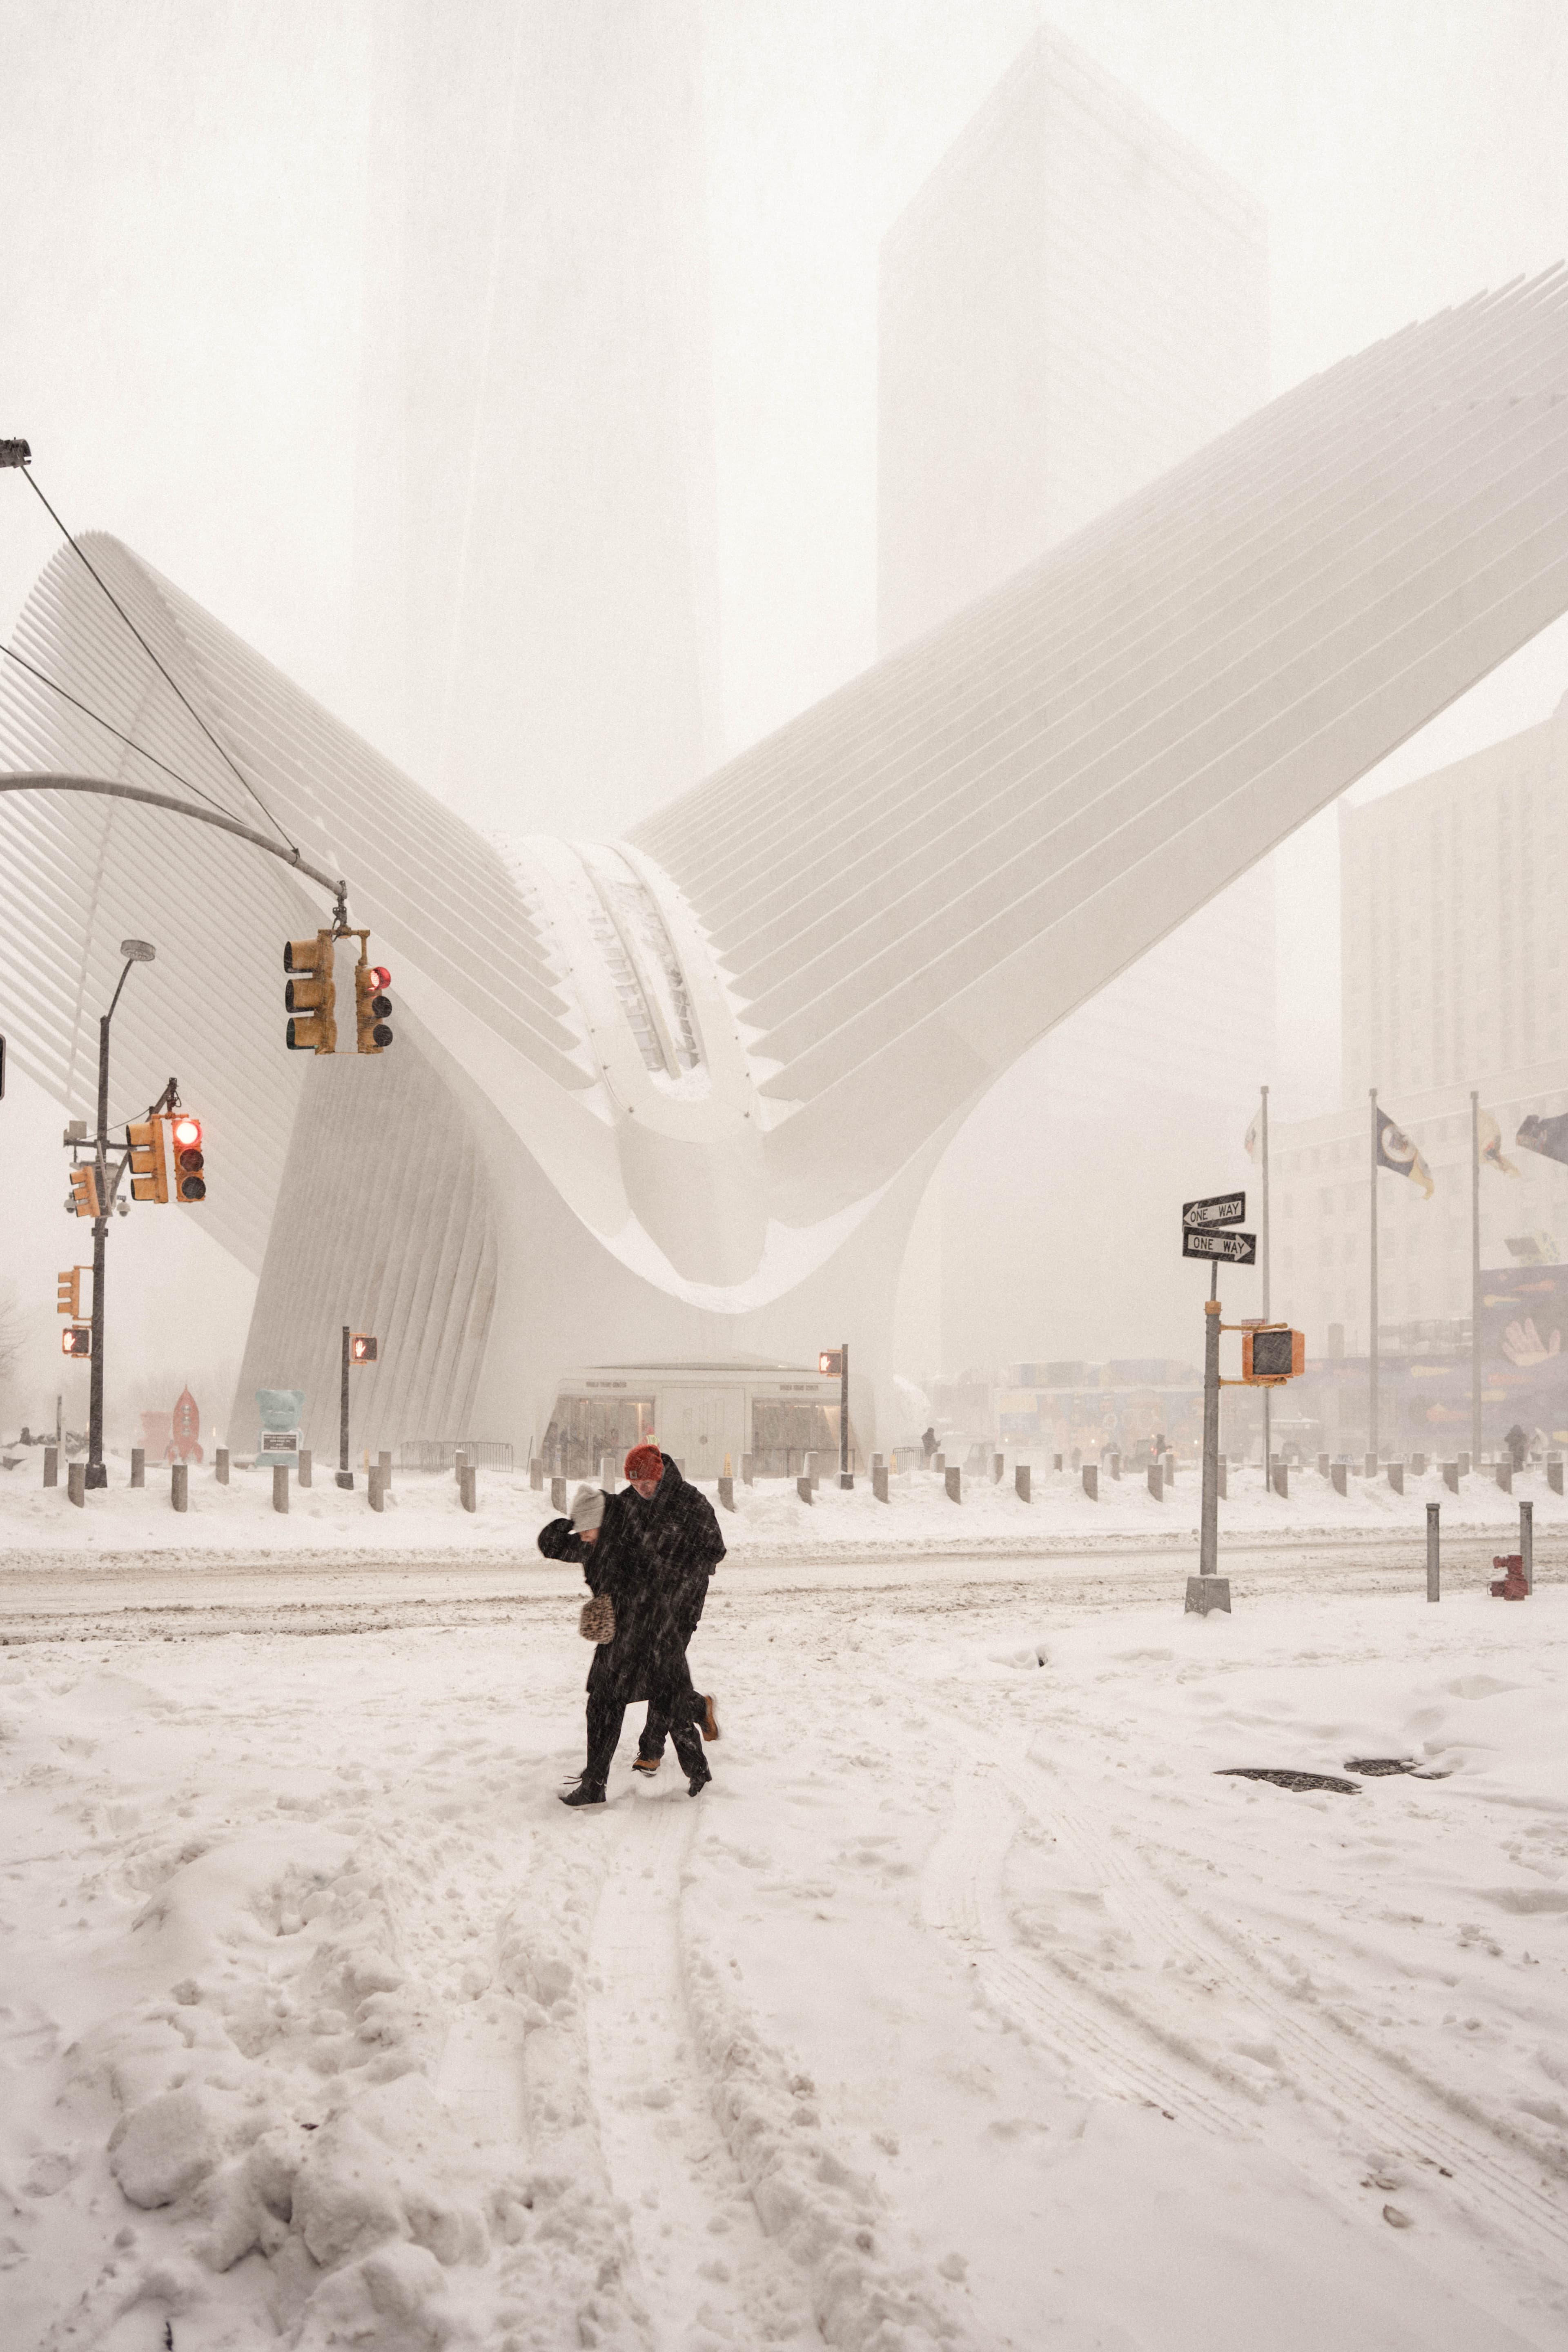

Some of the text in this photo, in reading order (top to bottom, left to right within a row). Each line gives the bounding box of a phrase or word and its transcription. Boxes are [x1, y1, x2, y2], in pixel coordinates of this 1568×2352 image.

[1190, 1203, 1239, 1223] ONE WAY
[1194, 1237, 1245, 1254] ONE WAY
